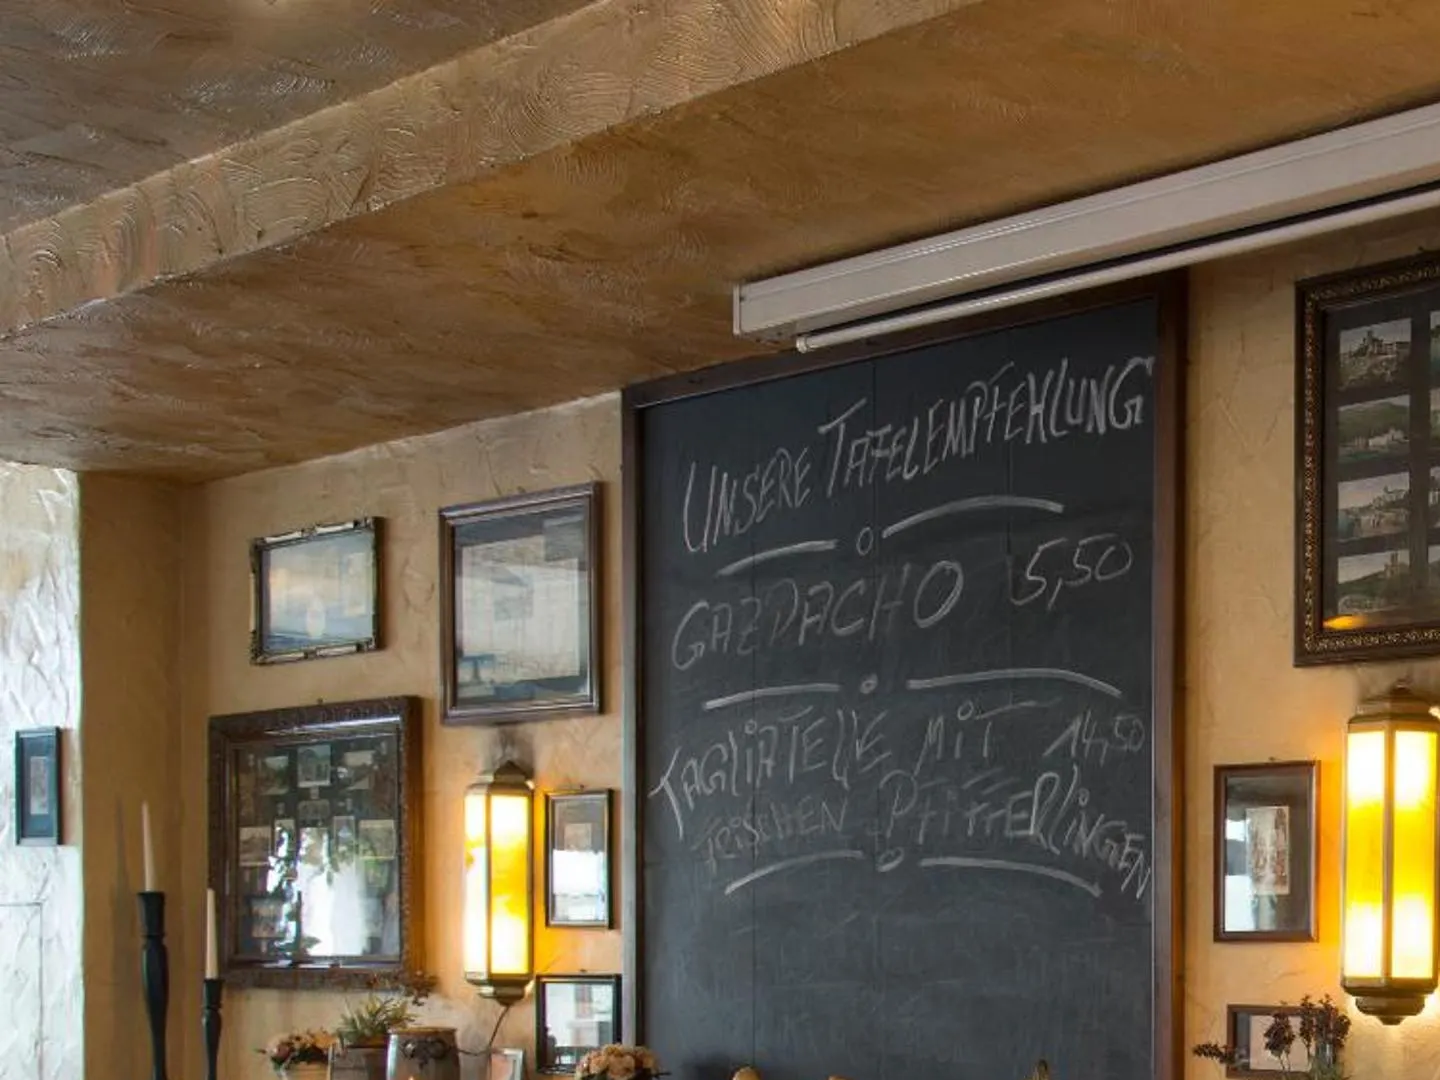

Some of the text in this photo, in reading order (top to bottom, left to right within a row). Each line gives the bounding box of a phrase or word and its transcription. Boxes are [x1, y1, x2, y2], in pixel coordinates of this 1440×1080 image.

[682, 356, 1156, 553] UNSERE TAFELEMPFEHLUNG
[1008, 532, 1133, 610] 5,50
[1042, 709, 1147, 769] 14,50
